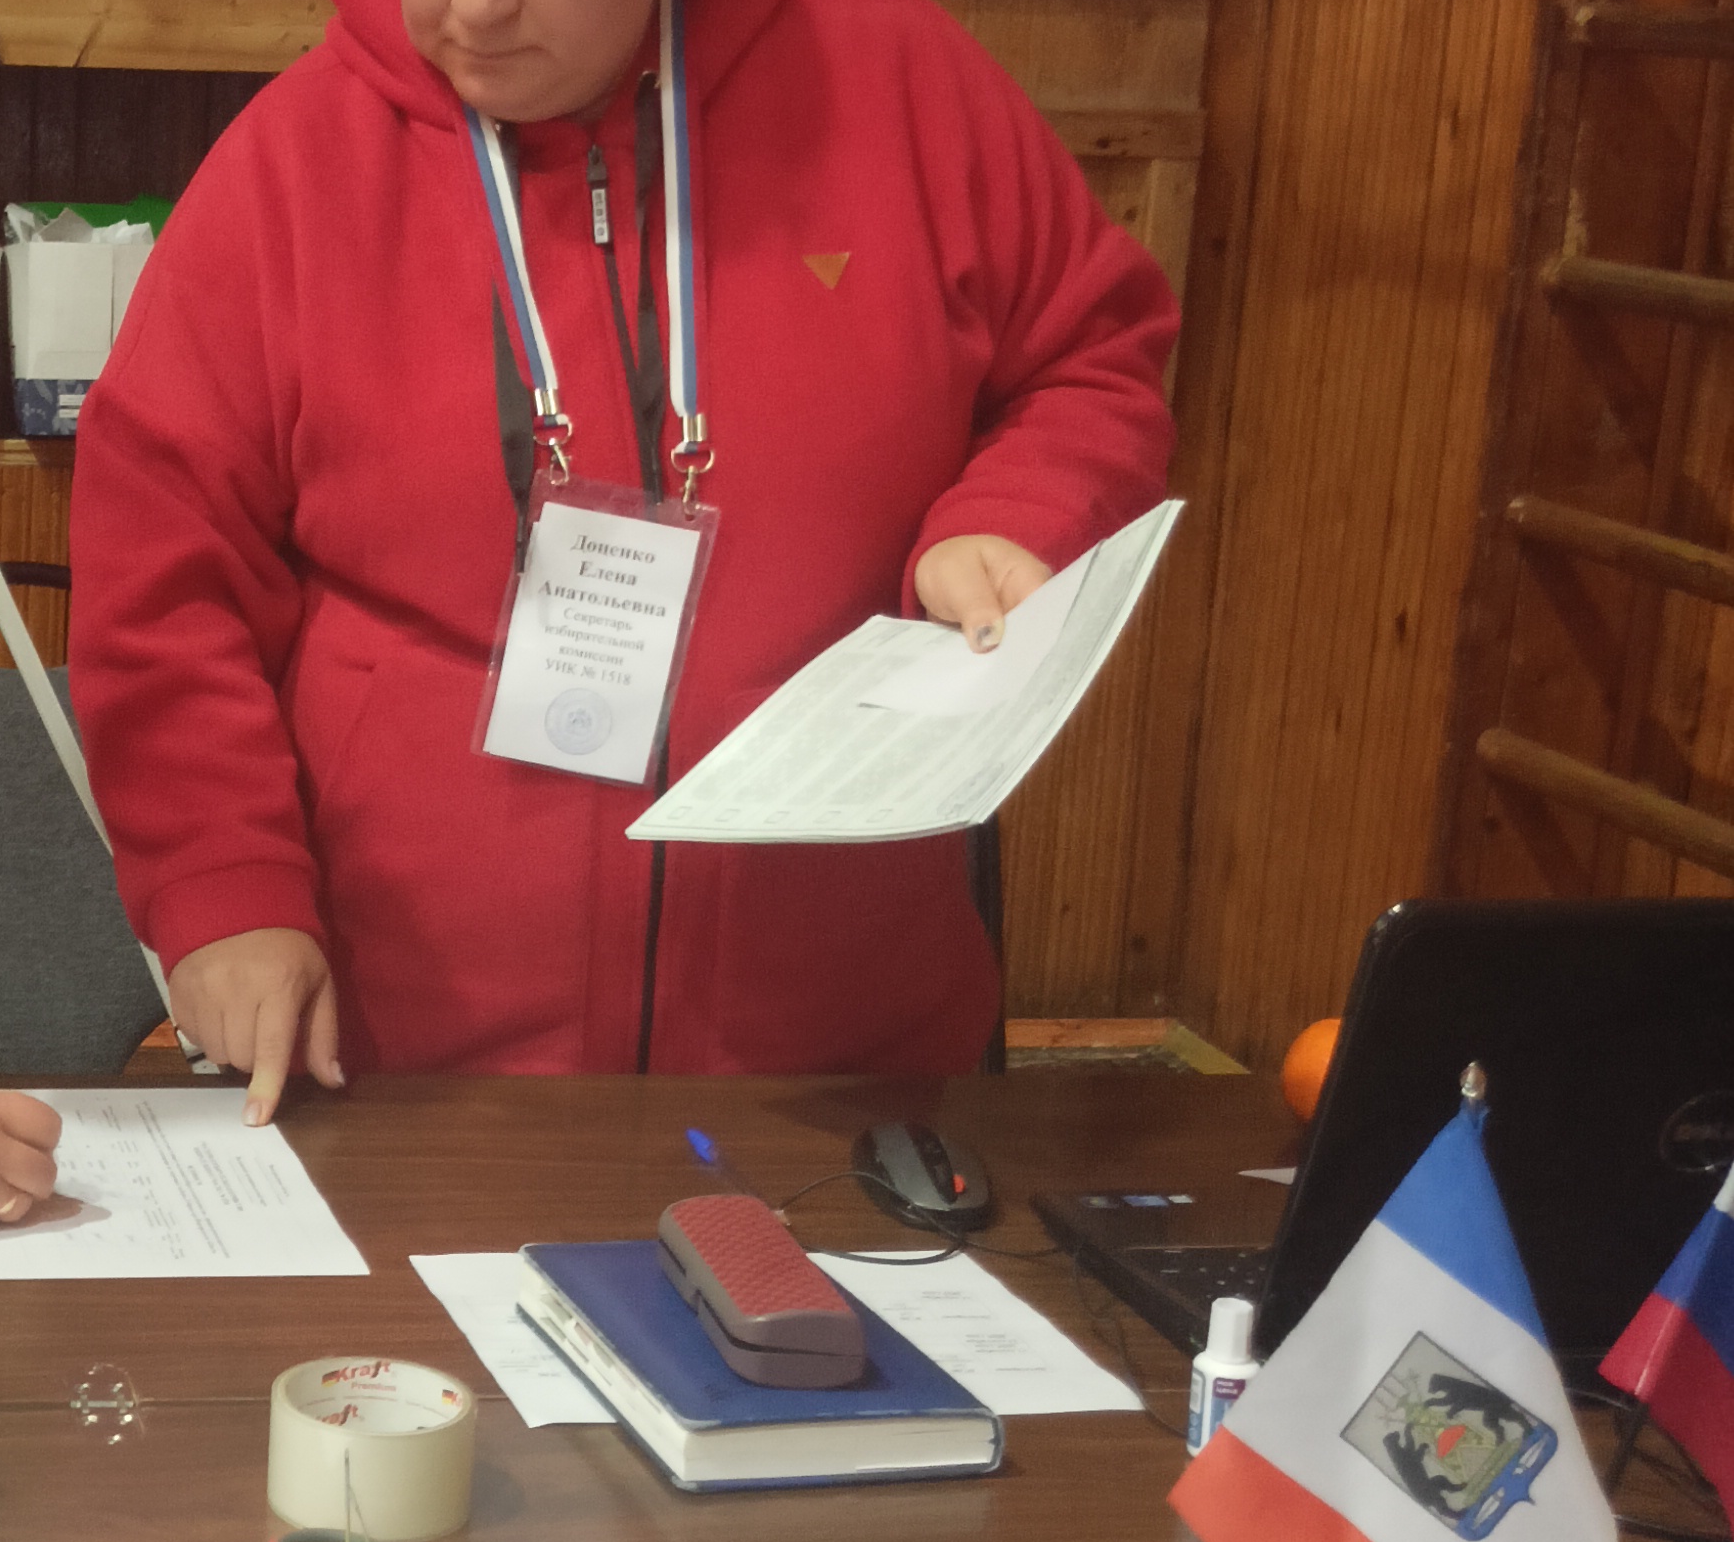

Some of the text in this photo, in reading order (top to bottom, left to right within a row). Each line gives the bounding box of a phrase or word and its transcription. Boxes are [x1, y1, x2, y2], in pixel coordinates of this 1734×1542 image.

[570, 534, 656, 564] Доценко
[579, 560, 638, 586] Елена
[538, 580, 666, 617] Анатольевна
[563, 607, 633, 631] Секретарь
[544, 625, 645, 651] избирательной
[558, 645, 624, 666] комиссии
[545, 658, 632, 685] УИК № 1518
[337, 1360, 392, 1381] Kraft
[351, 1381, 397, 1392] Premium
[321, 1404, 359, 1426] raft
